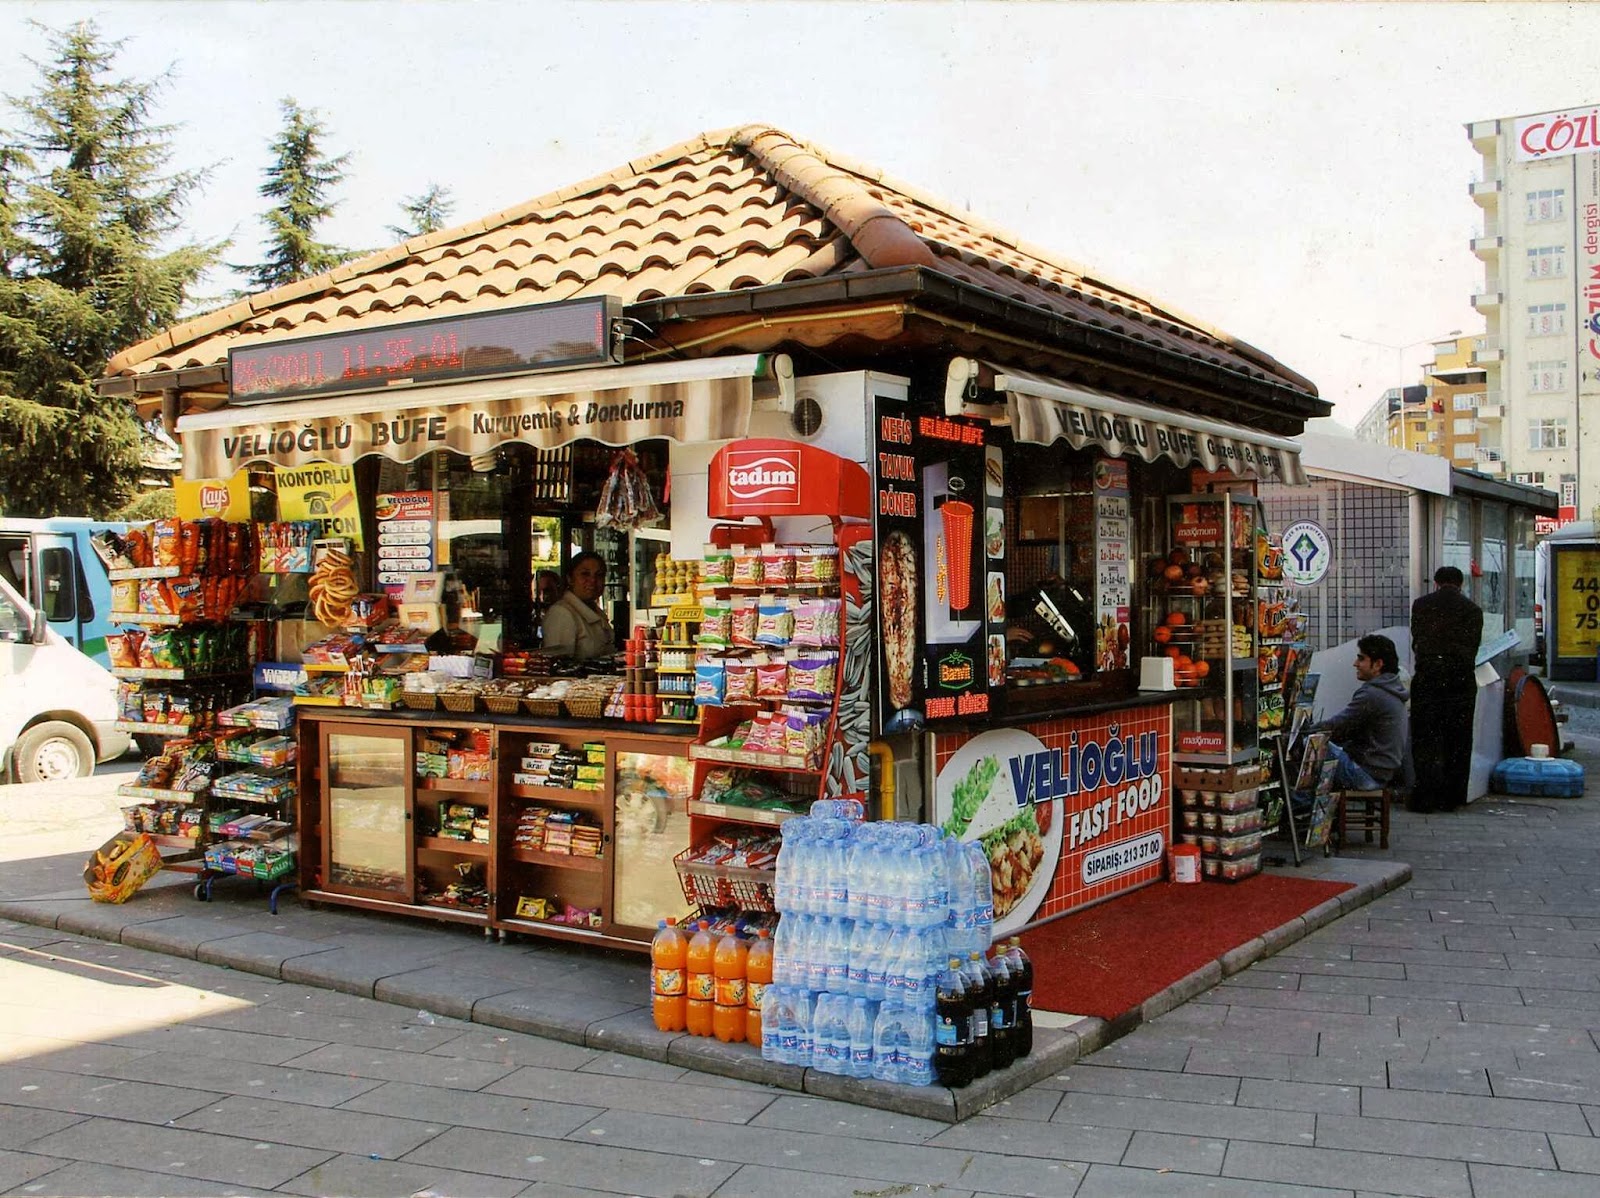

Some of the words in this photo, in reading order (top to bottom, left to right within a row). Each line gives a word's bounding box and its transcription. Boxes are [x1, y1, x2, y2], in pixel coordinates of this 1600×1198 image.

[372, 414, 447, 446] BÜFE
[473, 406, 563, 435] Kuruyemiş
[567, 406, 580, 425] &
[586, 396, 684, 424] Dondurma
[881, 412, 912, 445] NEFİS
[879, 452, 915, 482] TAVUK
[1244, 446, 1254, 463] &
[728, 466, 796, 486] tadım
[879, 484, 917, 518] DÖNER
[1008, 720, 1159, 808] VELİOĞLU
[1069, 797, 1113, 850] FAST
[1116, 773, 1162, 825] FOOD
[1087, 854, 1122, 877] SİPARİŞ:
[1123, 846, 1138, 865] 213
[1139, 844, 1149, 860] 37
[1149, 840, 1160, 855] 00
